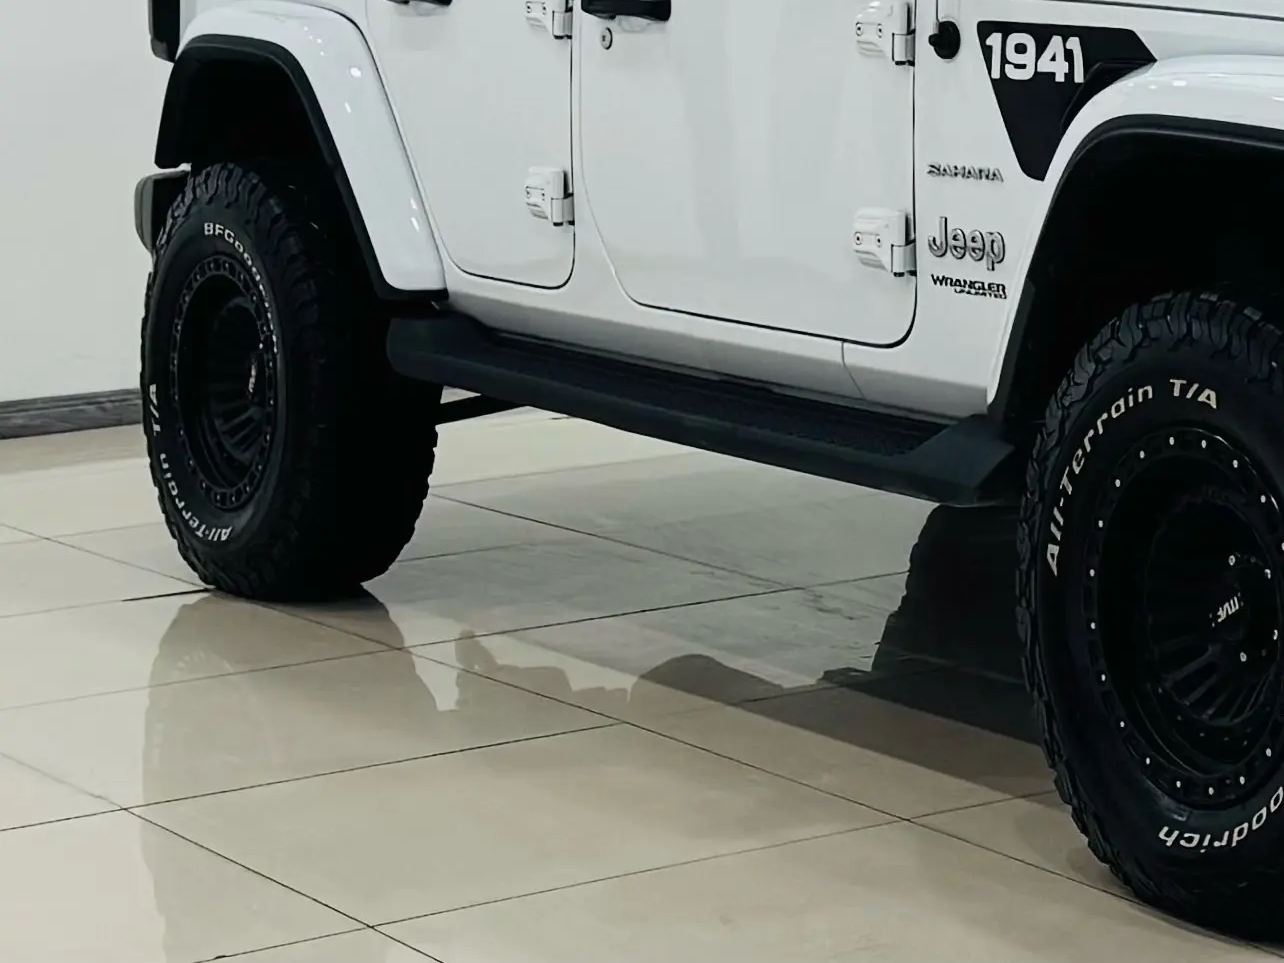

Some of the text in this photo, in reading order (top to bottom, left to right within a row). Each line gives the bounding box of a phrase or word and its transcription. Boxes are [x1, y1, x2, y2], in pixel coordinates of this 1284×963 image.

[985, 32, 1085, 84] 1941
[927, 164, 1004, 182] SAHARA
[928, 216, 1006, 272] Jeep
[930, 273, 1006, 296] WRANGLER
[1169, 379, 1217, 409] T/A
